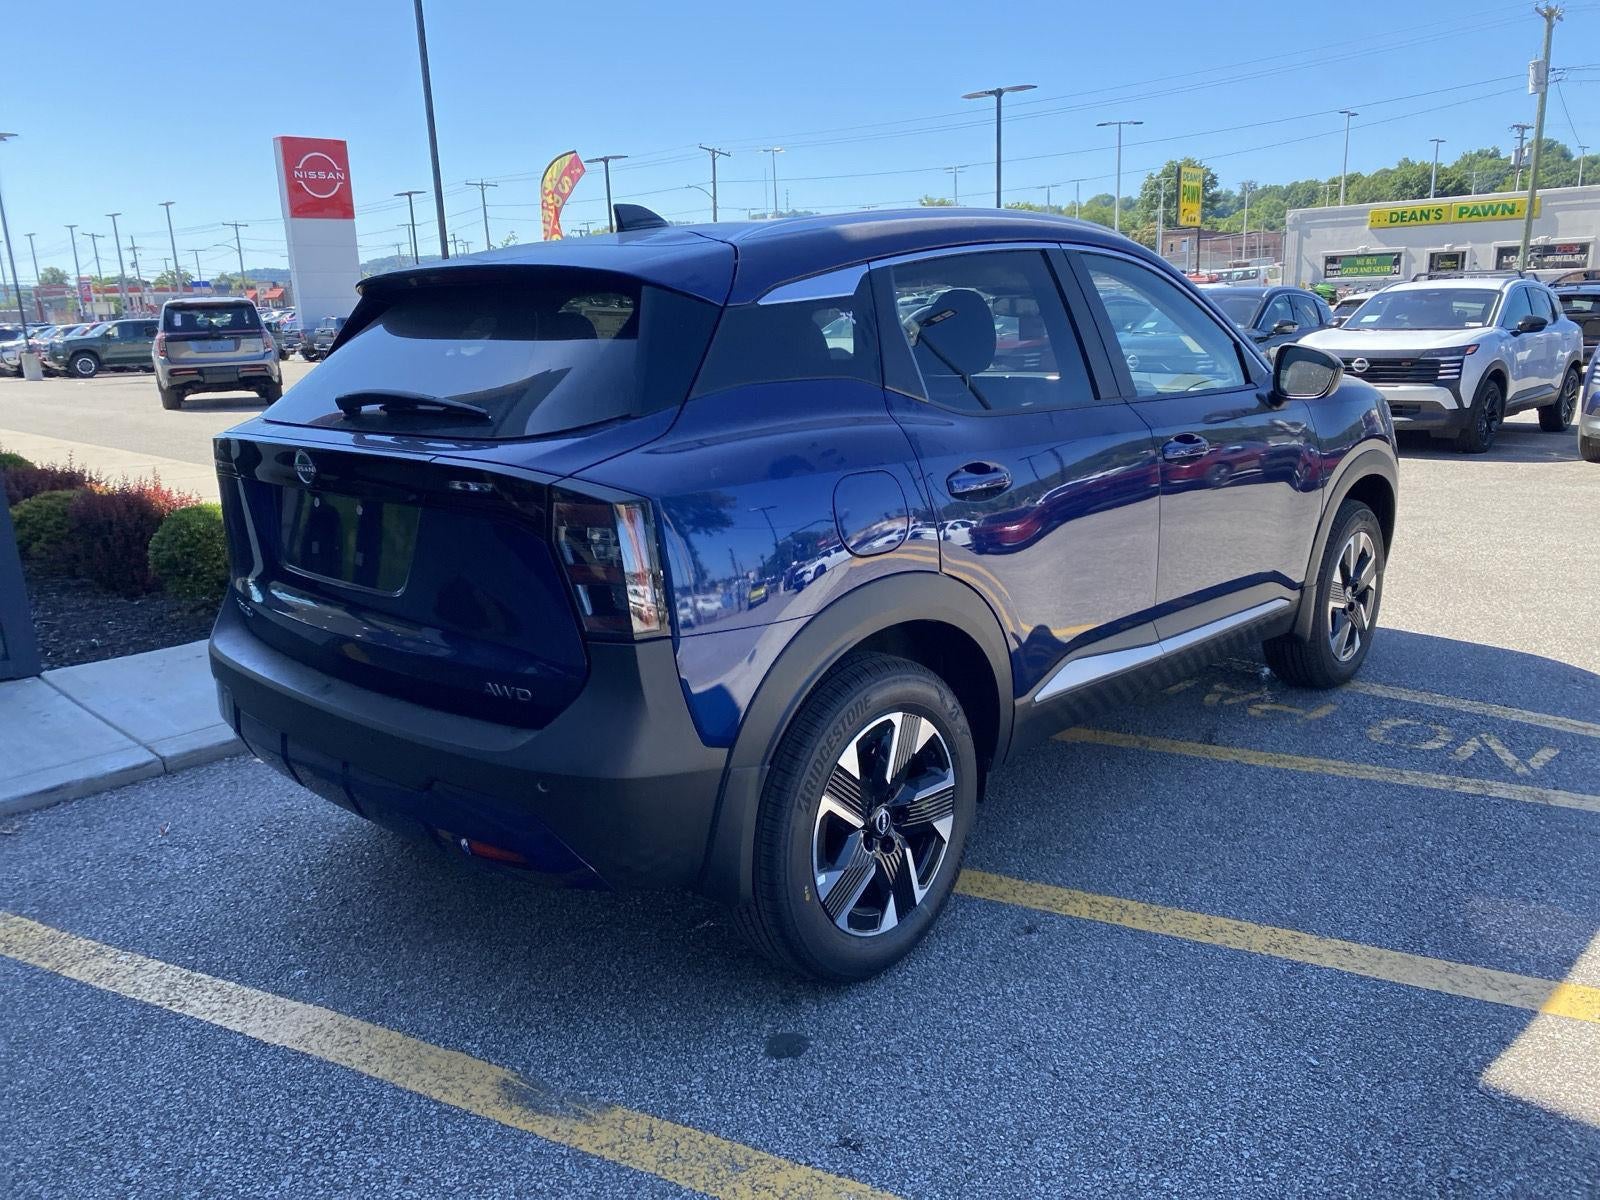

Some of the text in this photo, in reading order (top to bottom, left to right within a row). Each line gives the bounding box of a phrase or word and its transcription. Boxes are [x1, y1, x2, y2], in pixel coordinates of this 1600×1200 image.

[293, 170, 345, 180] NISSAN
[1543, 253, 1587, 262] JEWELRY
[1342, 266, 1358, 274] GOLD
[1372, 265, 1391, 273] SILVER
[483, 682, 532, 702] AWD
[797, 695, 872, 815] BRIDGESTONE
